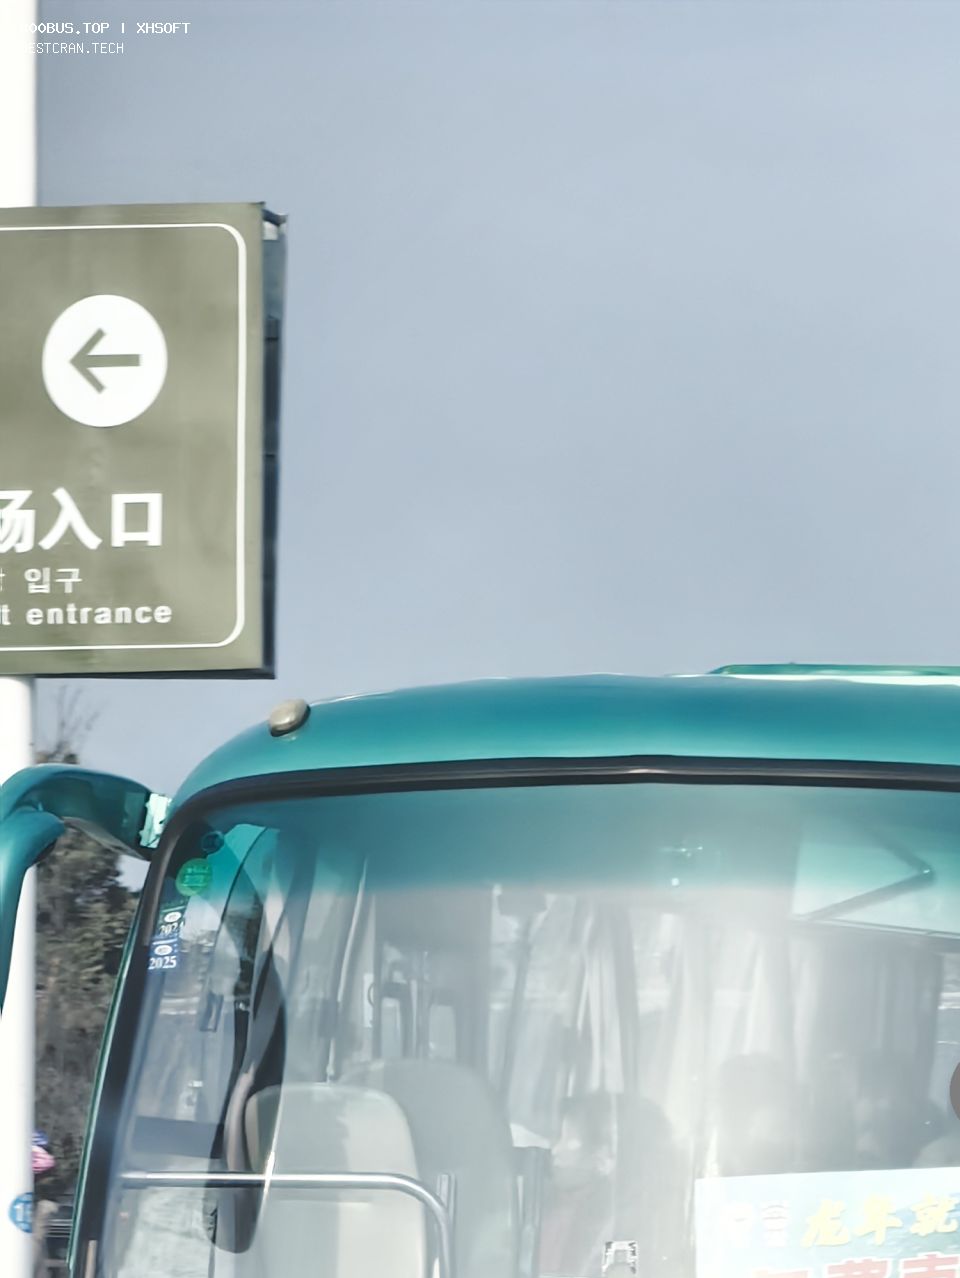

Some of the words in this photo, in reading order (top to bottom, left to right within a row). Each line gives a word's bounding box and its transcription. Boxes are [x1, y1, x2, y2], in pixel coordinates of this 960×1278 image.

[24, 567, 83, 593] 입구
[26, 603, 173, 625] entrance
[148, 955, 177, 970] 2025
